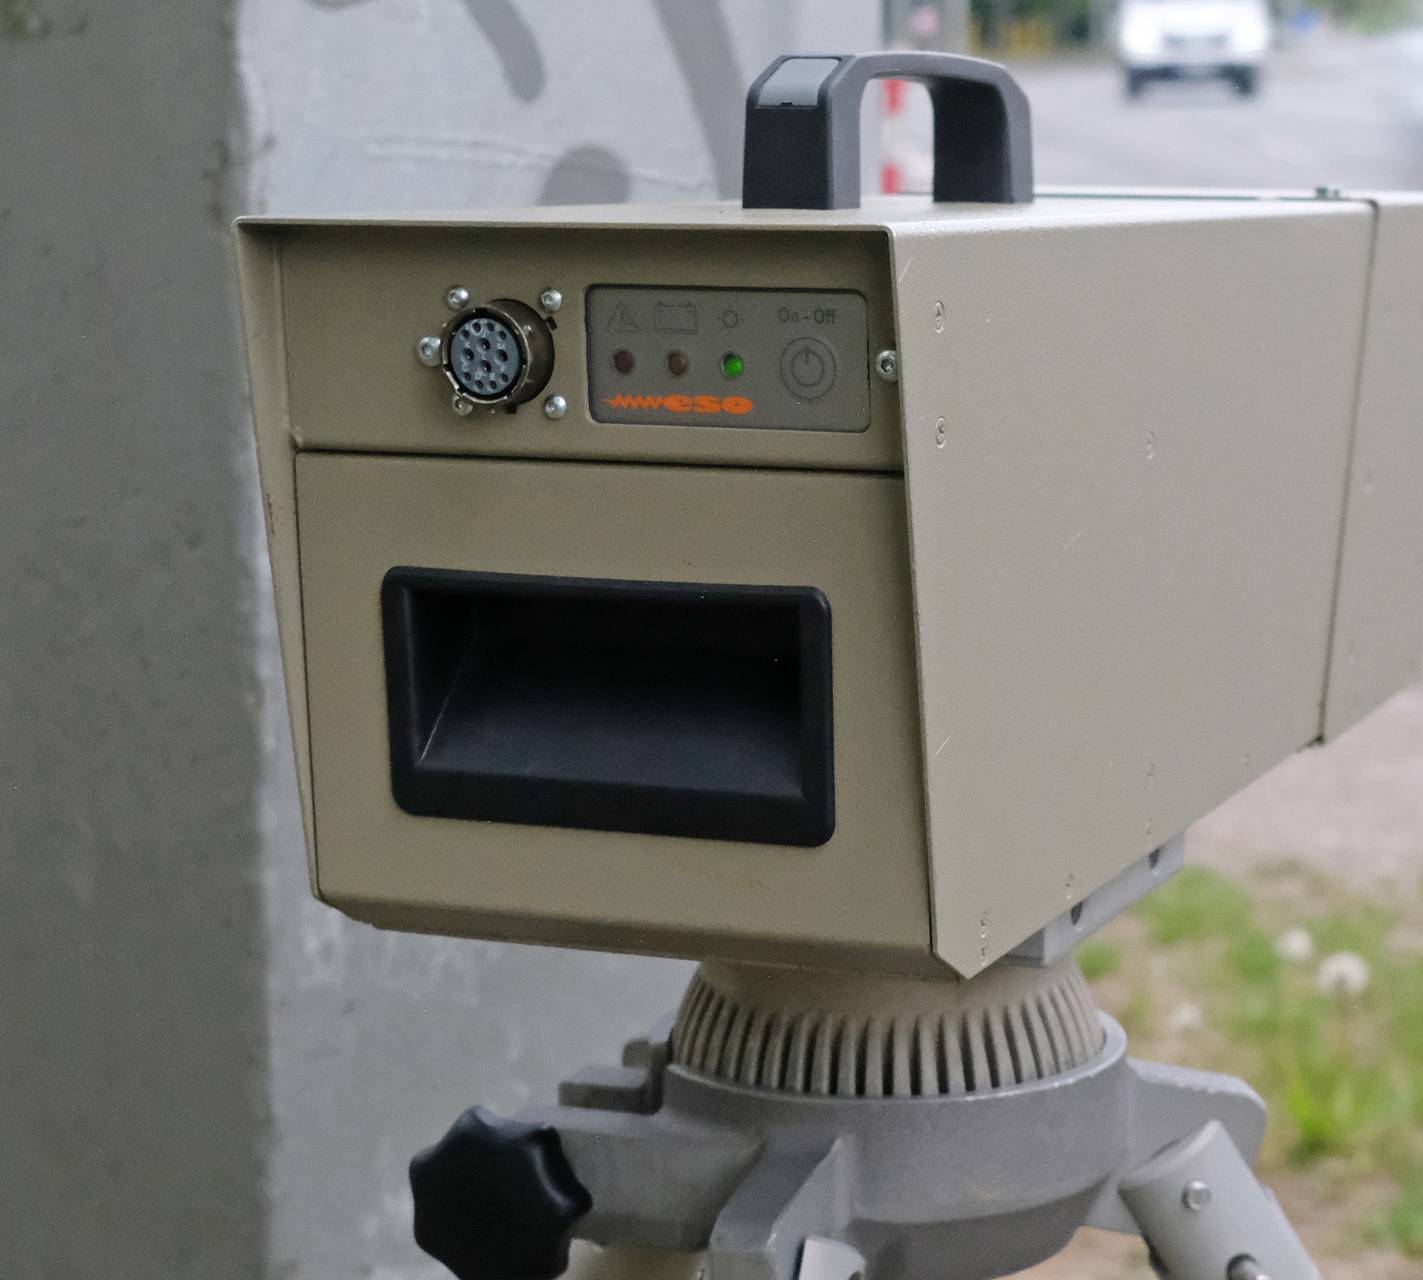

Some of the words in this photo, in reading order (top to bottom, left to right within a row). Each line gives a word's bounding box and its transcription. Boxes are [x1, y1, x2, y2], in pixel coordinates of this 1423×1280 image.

[779, 307, 799, 324] On
[813, 307, 837, 325] Off
[662, 394, 753, 415] eso
